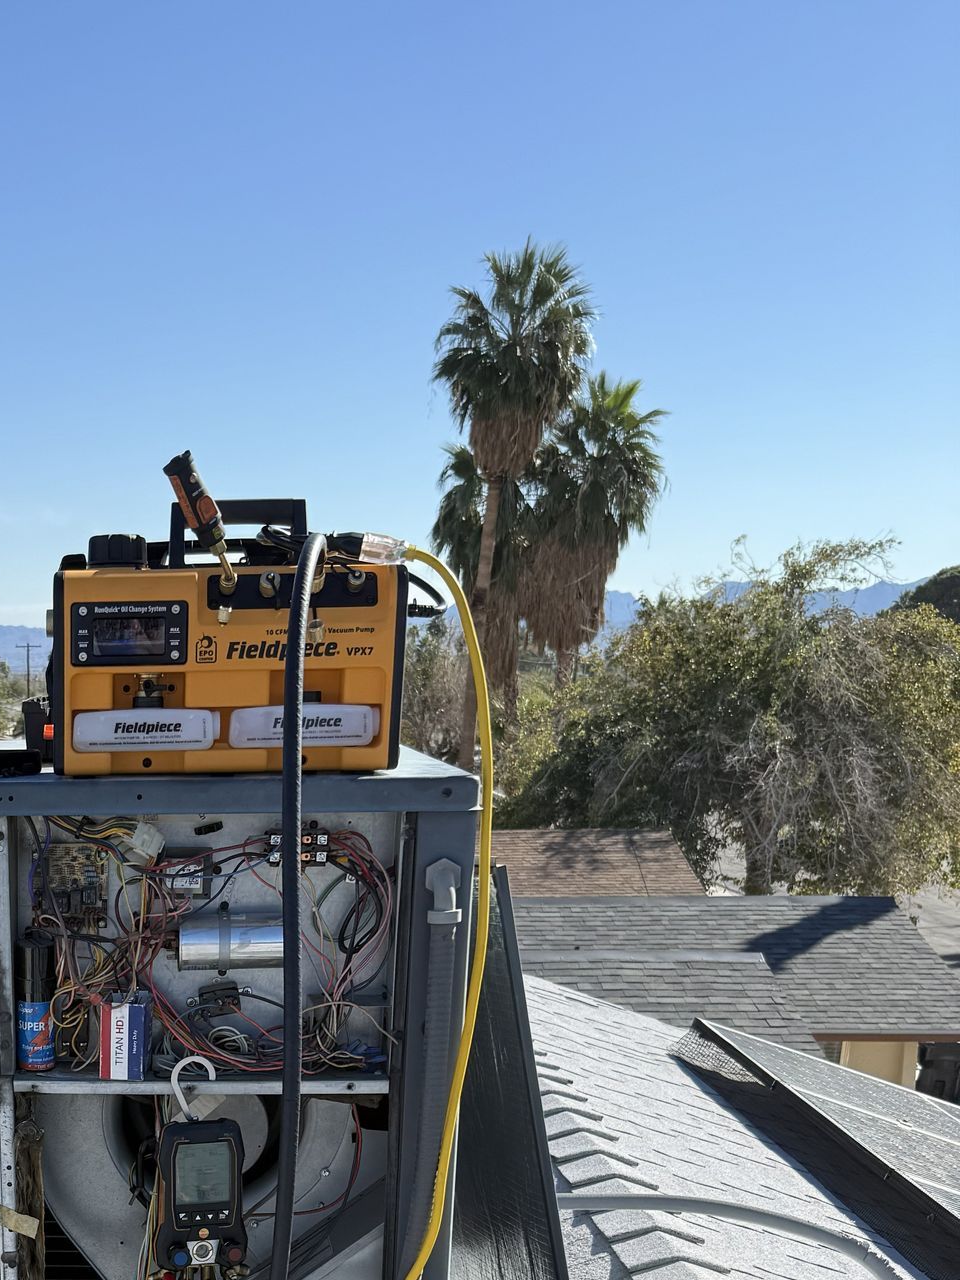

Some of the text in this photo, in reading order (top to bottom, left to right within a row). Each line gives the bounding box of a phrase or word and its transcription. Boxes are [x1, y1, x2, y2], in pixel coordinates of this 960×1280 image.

[129, 605, 148, 614] Change
[148, 605, 167, 613] System
[355, 626, 375, 634] Pump
[226, 640, 338, 661] Fieldpece
[346, 646, 374, 657] VPX7
[114, 722, 182, 734] Fieldpiece
[272, 716, 342, 730] Fipiece
[18, 1020, 45, 1032] SUPER
[115, 1019, 124, 1065] TITAN HD
